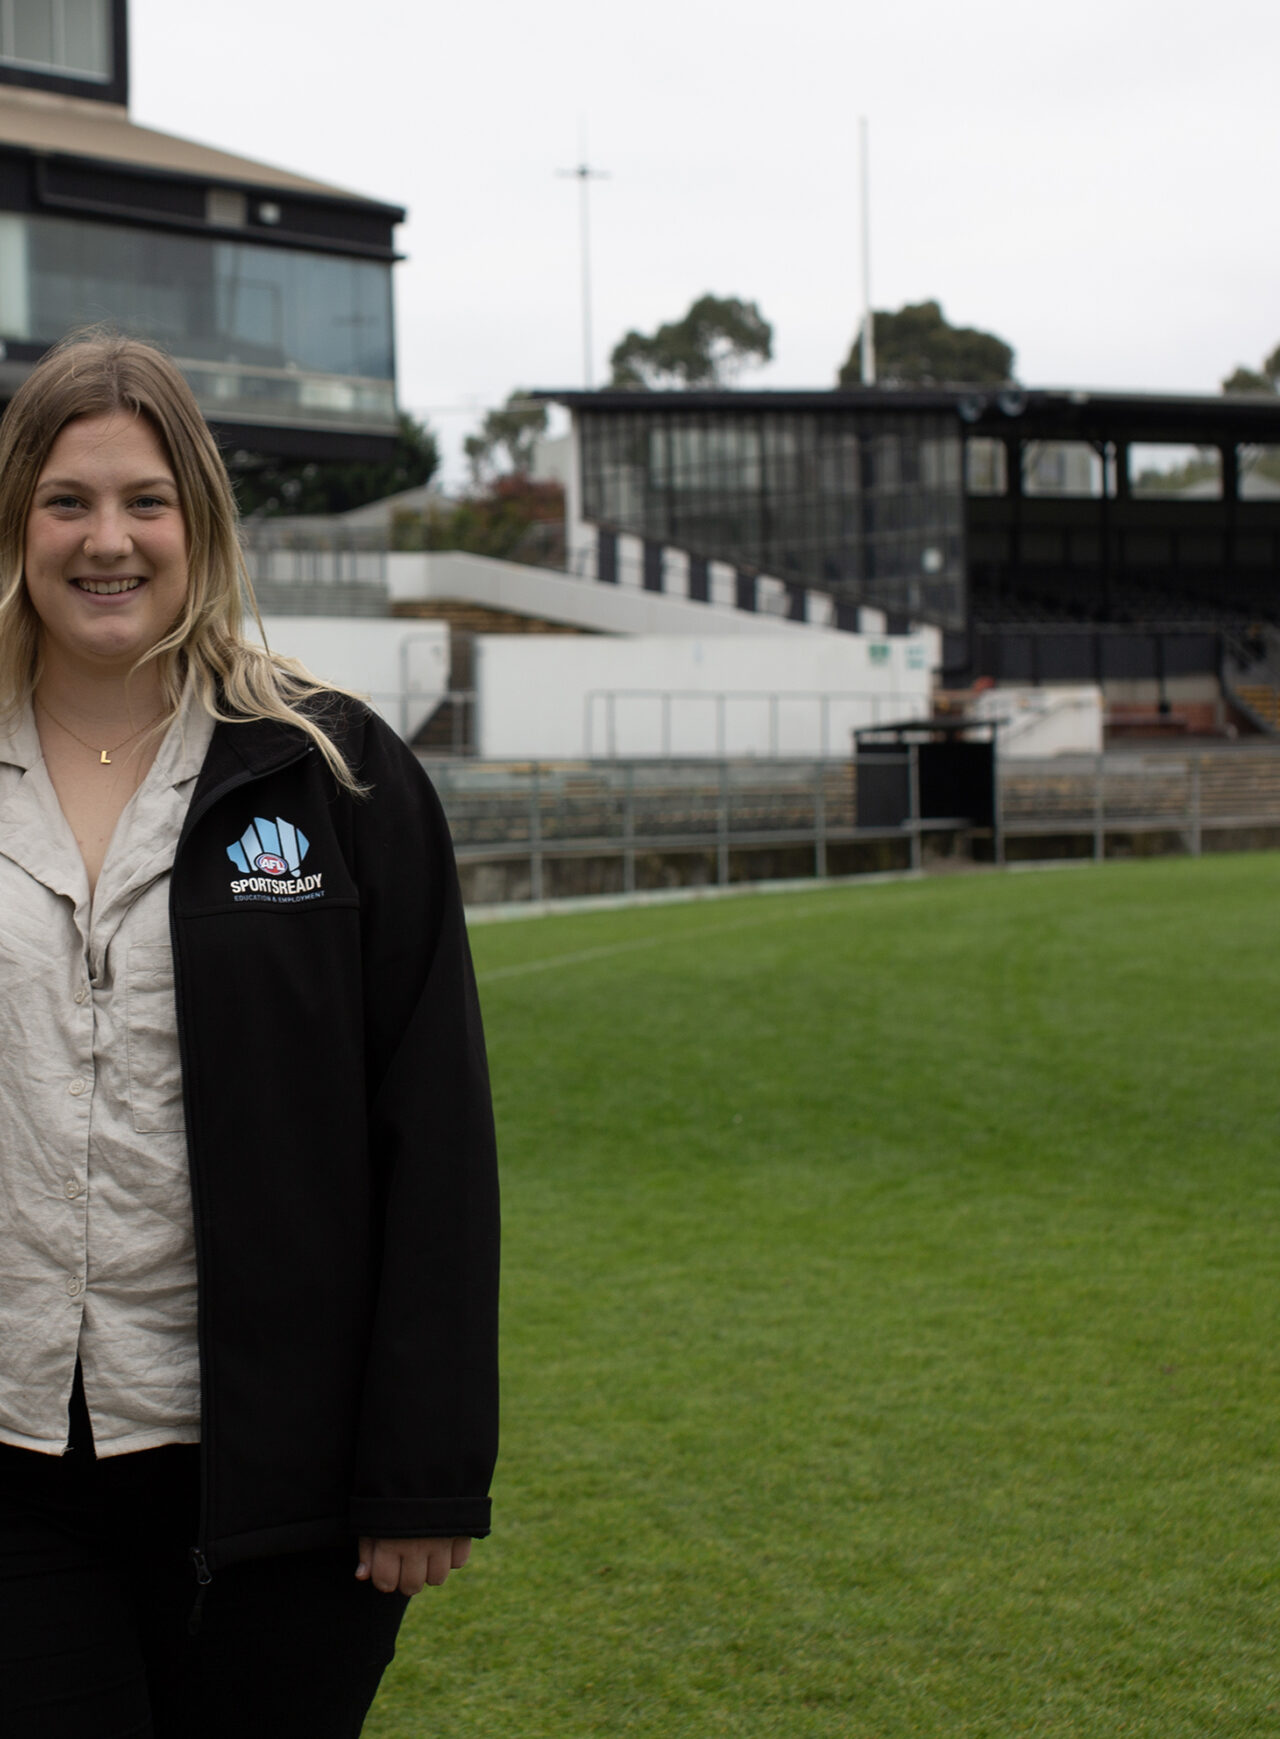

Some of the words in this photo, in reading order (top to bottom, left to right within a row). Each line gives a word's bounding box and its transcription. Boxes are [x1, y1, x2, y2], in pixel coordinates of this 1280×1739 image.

[101, 750, 111, 764] L
[261, 858, 285, 871] AFL
[230, 873, 322, 895] SPORTSREADY
[234, 894, 271, 902] EDUCATION
[278, 890, 325, 903] EMPLOYMENT
